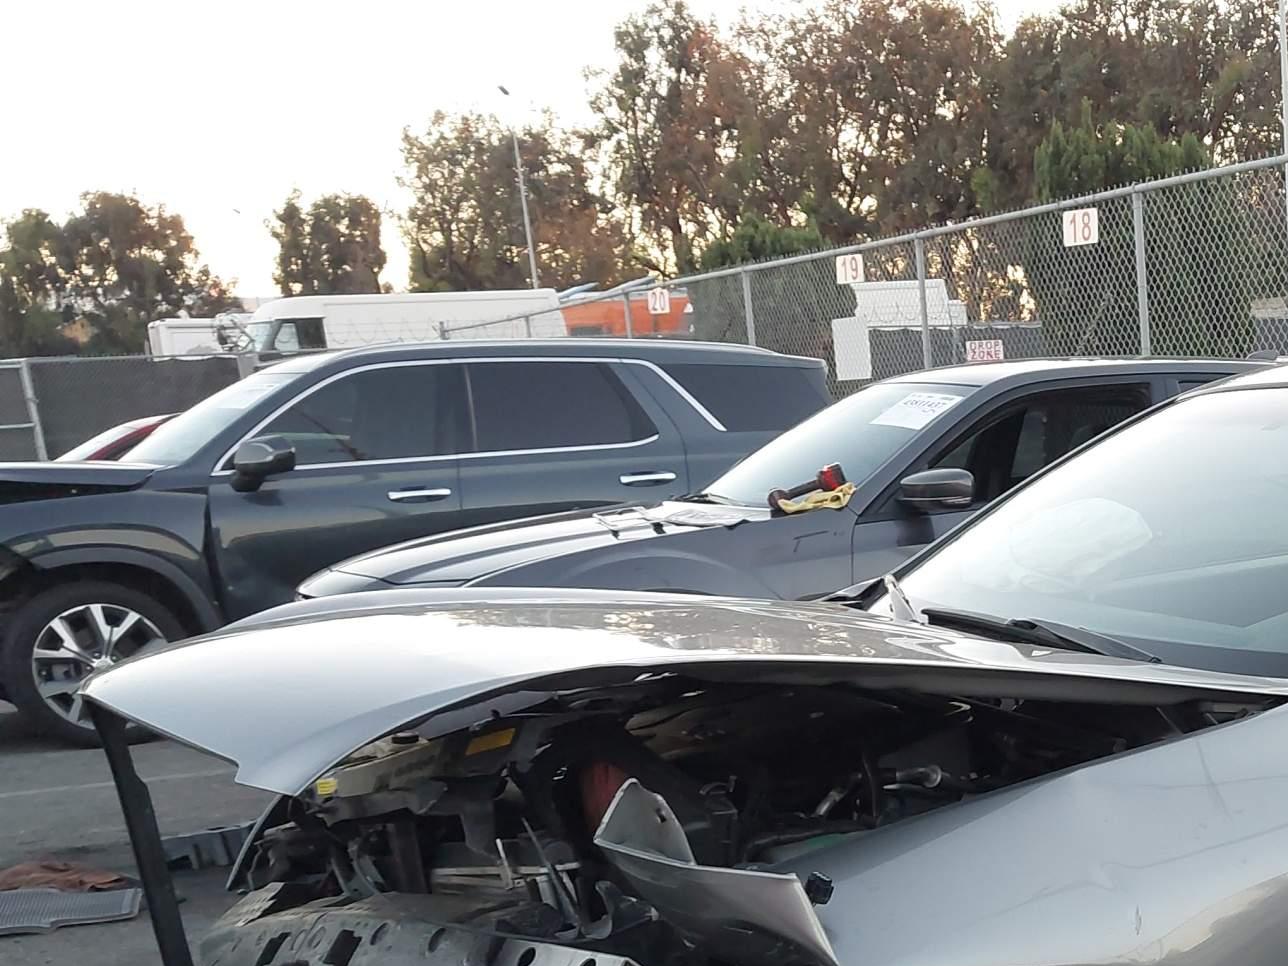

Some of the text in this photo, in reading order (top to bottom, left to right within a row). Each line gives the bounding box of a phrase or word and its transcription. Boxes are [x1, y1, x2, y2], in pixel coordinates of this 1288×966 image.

[1069, 210, 1092, 244] 18
[840, 255, 859, 282] 19
[651, 290, 666, 312] 20
[969, 340, 1001, 351] DROP
[970, 350, 1001, 361] ZONE
